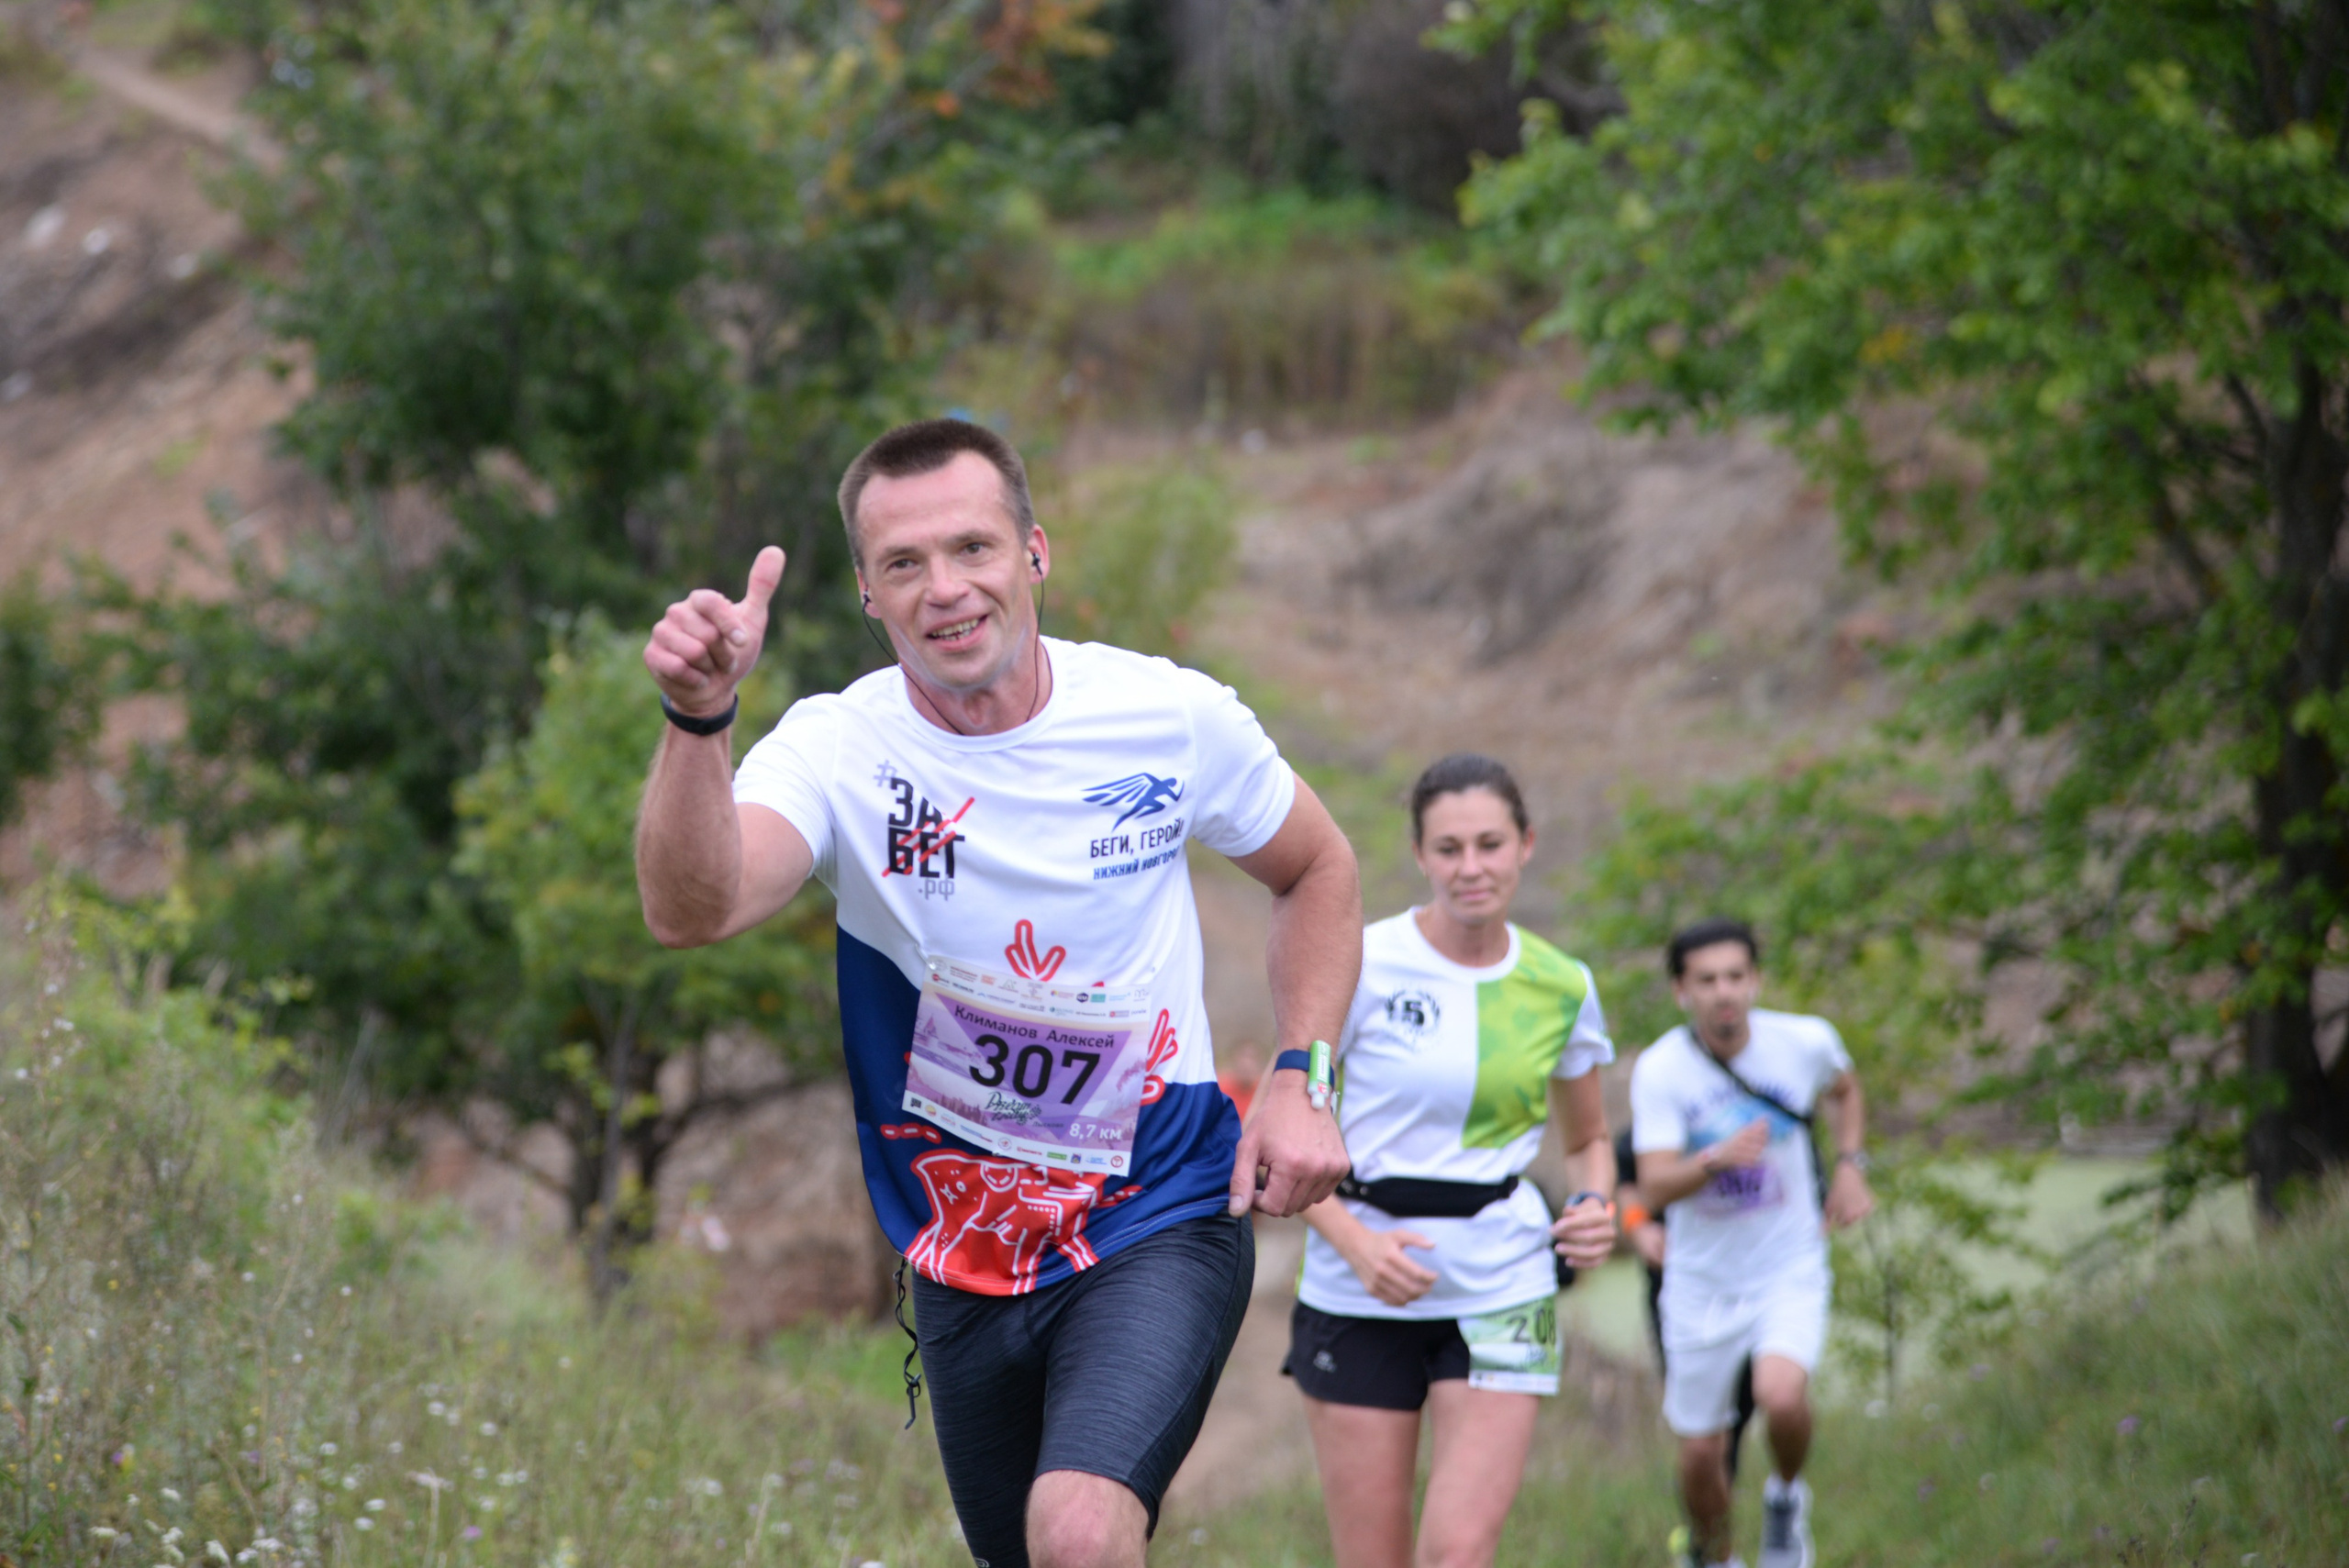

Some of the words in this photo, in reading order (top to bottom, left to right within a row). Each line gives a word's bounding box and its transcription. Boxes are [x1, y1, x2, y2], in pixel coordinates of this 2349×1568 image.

[888, 827, 965, 878] БЕГ
[1090, 835, 1134, 859] БЕГИ,
[1141, 817, 1184, 850] ГЕРОЙ!
[1094, 858, 1139, 880] НИЖНИЙ
[1141, 846, 1180, 871] НОВГОРО
[954, 1005, 1038, 1039] Климанов
[1046, 1029, 1115, 1048] Алексей
[969, 1034, 1100, 1105] 307
[1069, 1122, 1097, 1140] 8,7
